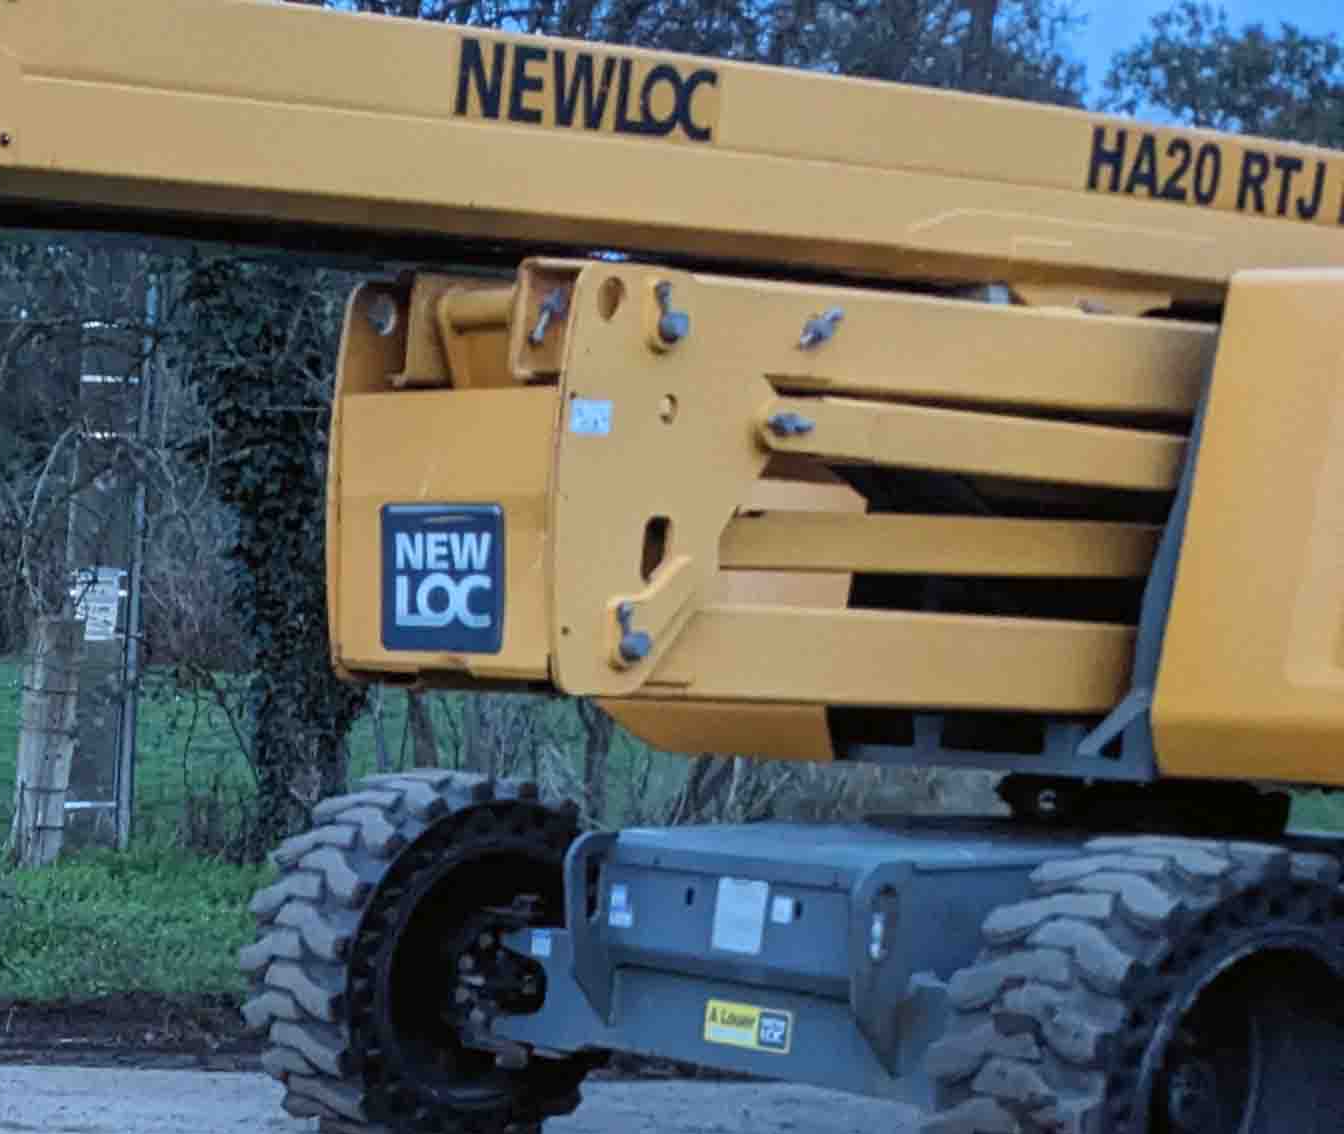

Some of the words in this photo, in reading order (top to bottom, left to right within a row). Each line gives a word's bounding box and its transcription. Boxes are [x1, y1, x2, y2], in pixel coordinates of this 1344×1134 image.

[453, 37, 718, 142] NEWLOC
[1087, 125, 1221, 206] HA20
[1235, 148, 1326, 220] RTJ
[395, 531, 492, 571] NEW
[395, 571, 492, 629] LOC
